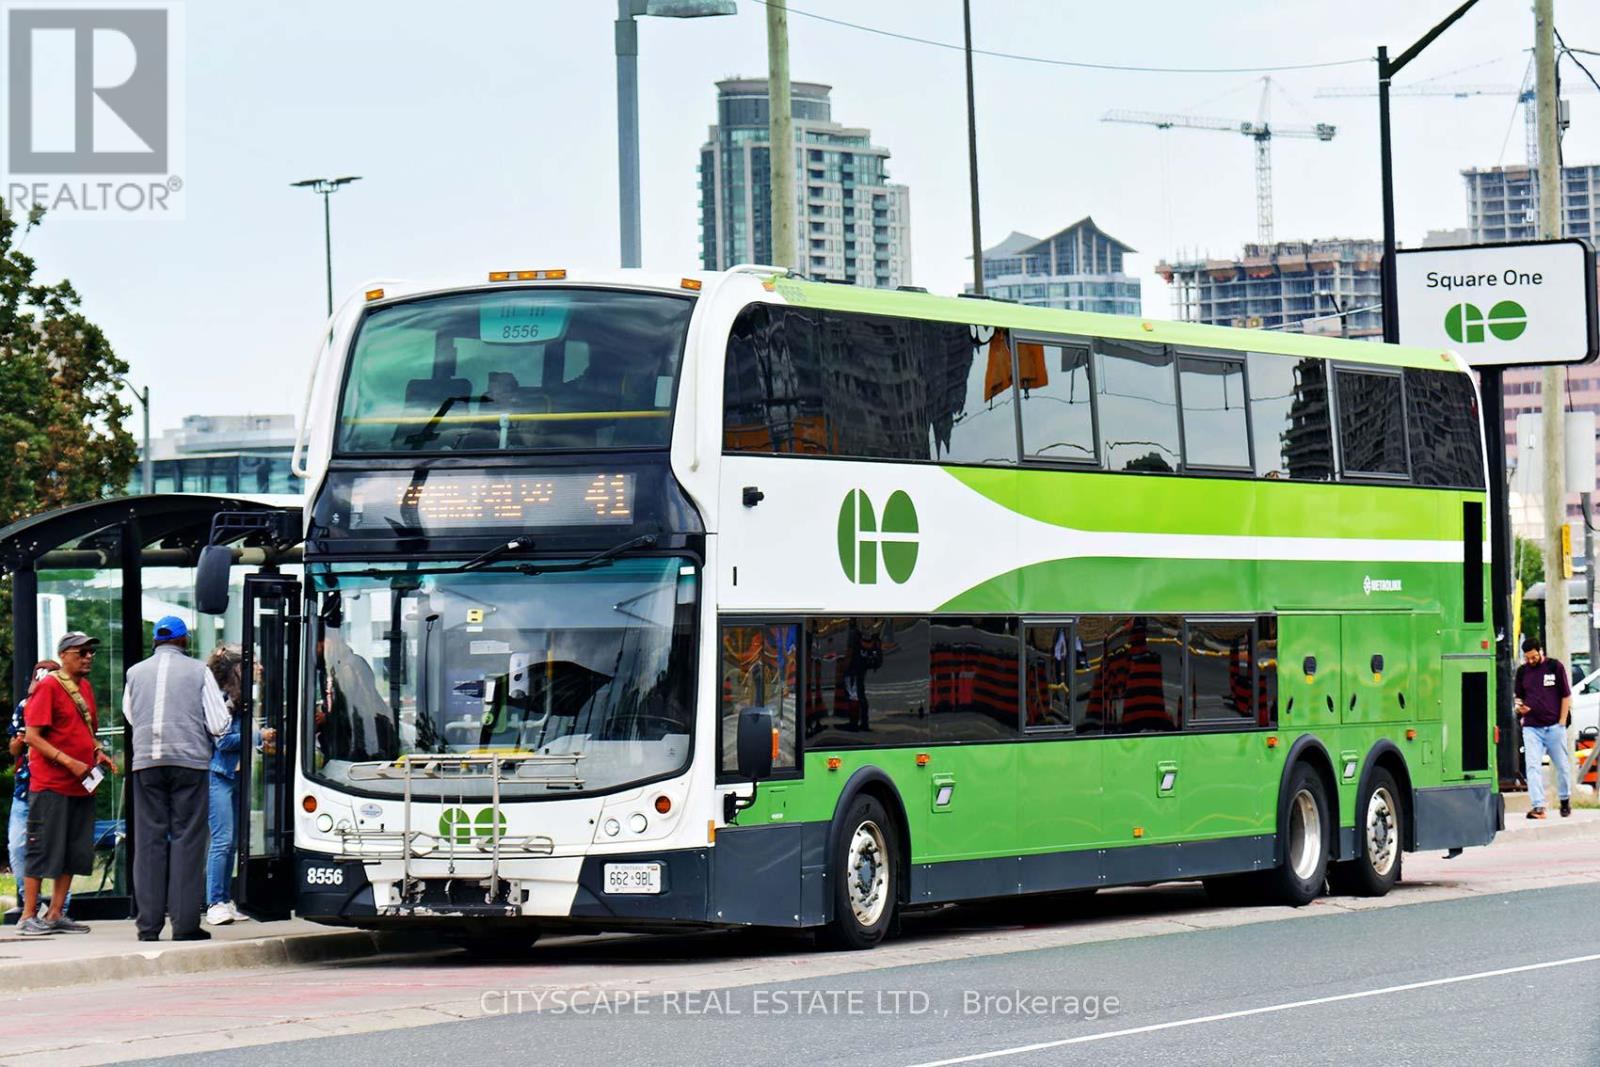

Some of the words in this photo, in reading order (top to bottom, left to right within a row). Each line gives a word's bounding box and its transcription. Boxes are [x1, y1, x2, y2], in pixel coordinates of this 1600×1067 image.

[1426, 272, 1497, 291] Square
[1503, 269, 1543, 286] One
[502, 324, 539, 339] 8556
[1444, 300, 1527, 343] GO
[584, 474, 630, 515] 41
[837, 488, 919, 585] GO
[439, 807, 507, 845] GO
[307, 867, 343, 885] 8556
[610, 871, 629, 886] 662
[635, 871, 654, 886] 9BL
